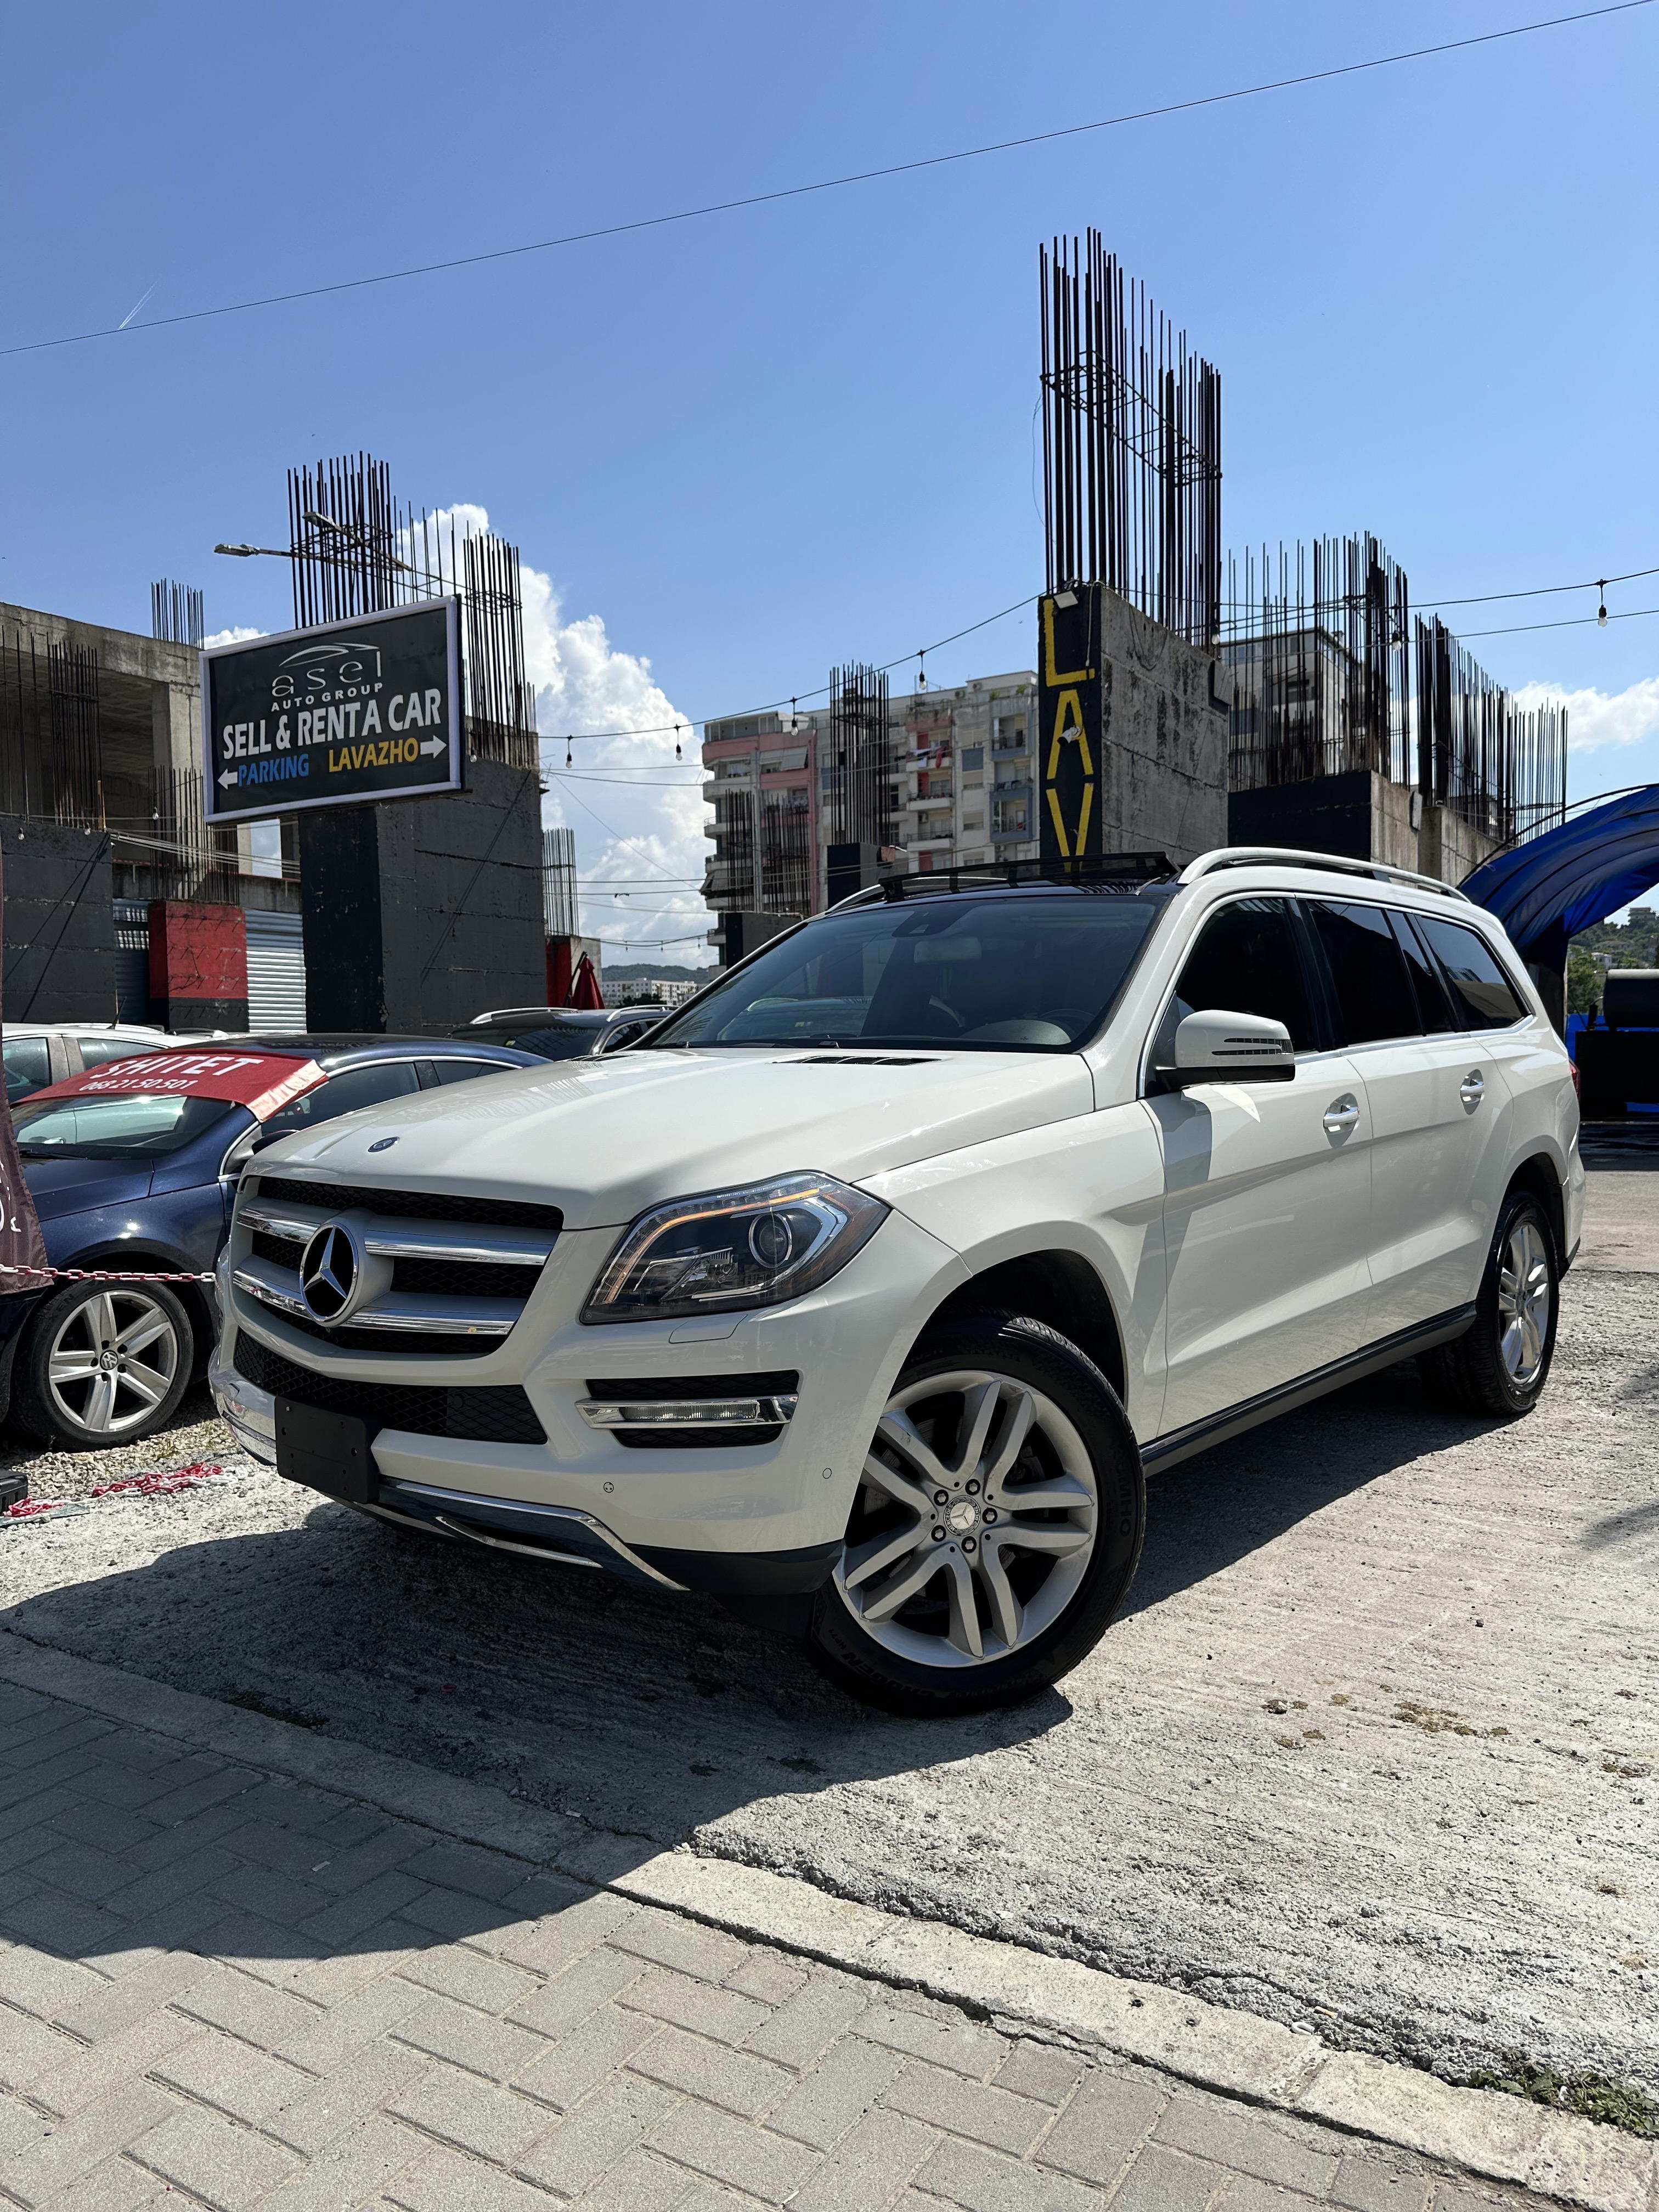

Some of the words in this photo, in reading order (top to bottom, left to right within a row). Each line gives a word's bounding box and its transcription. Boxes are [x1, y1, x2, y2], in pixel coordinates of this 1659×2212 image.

[271, 695, 314, 712] AUTO
[321, 682, 383, 702] GROUP
[223, 719, 272, 759] SELL
[276, 714, 291, 750] &
[388, 688, 441, 732] CAR
[238, 753, 309, 787] PARKING
[329, 737, 419, 772] LAVAZHO
[90, 1056, 264, 1079] SHITET
